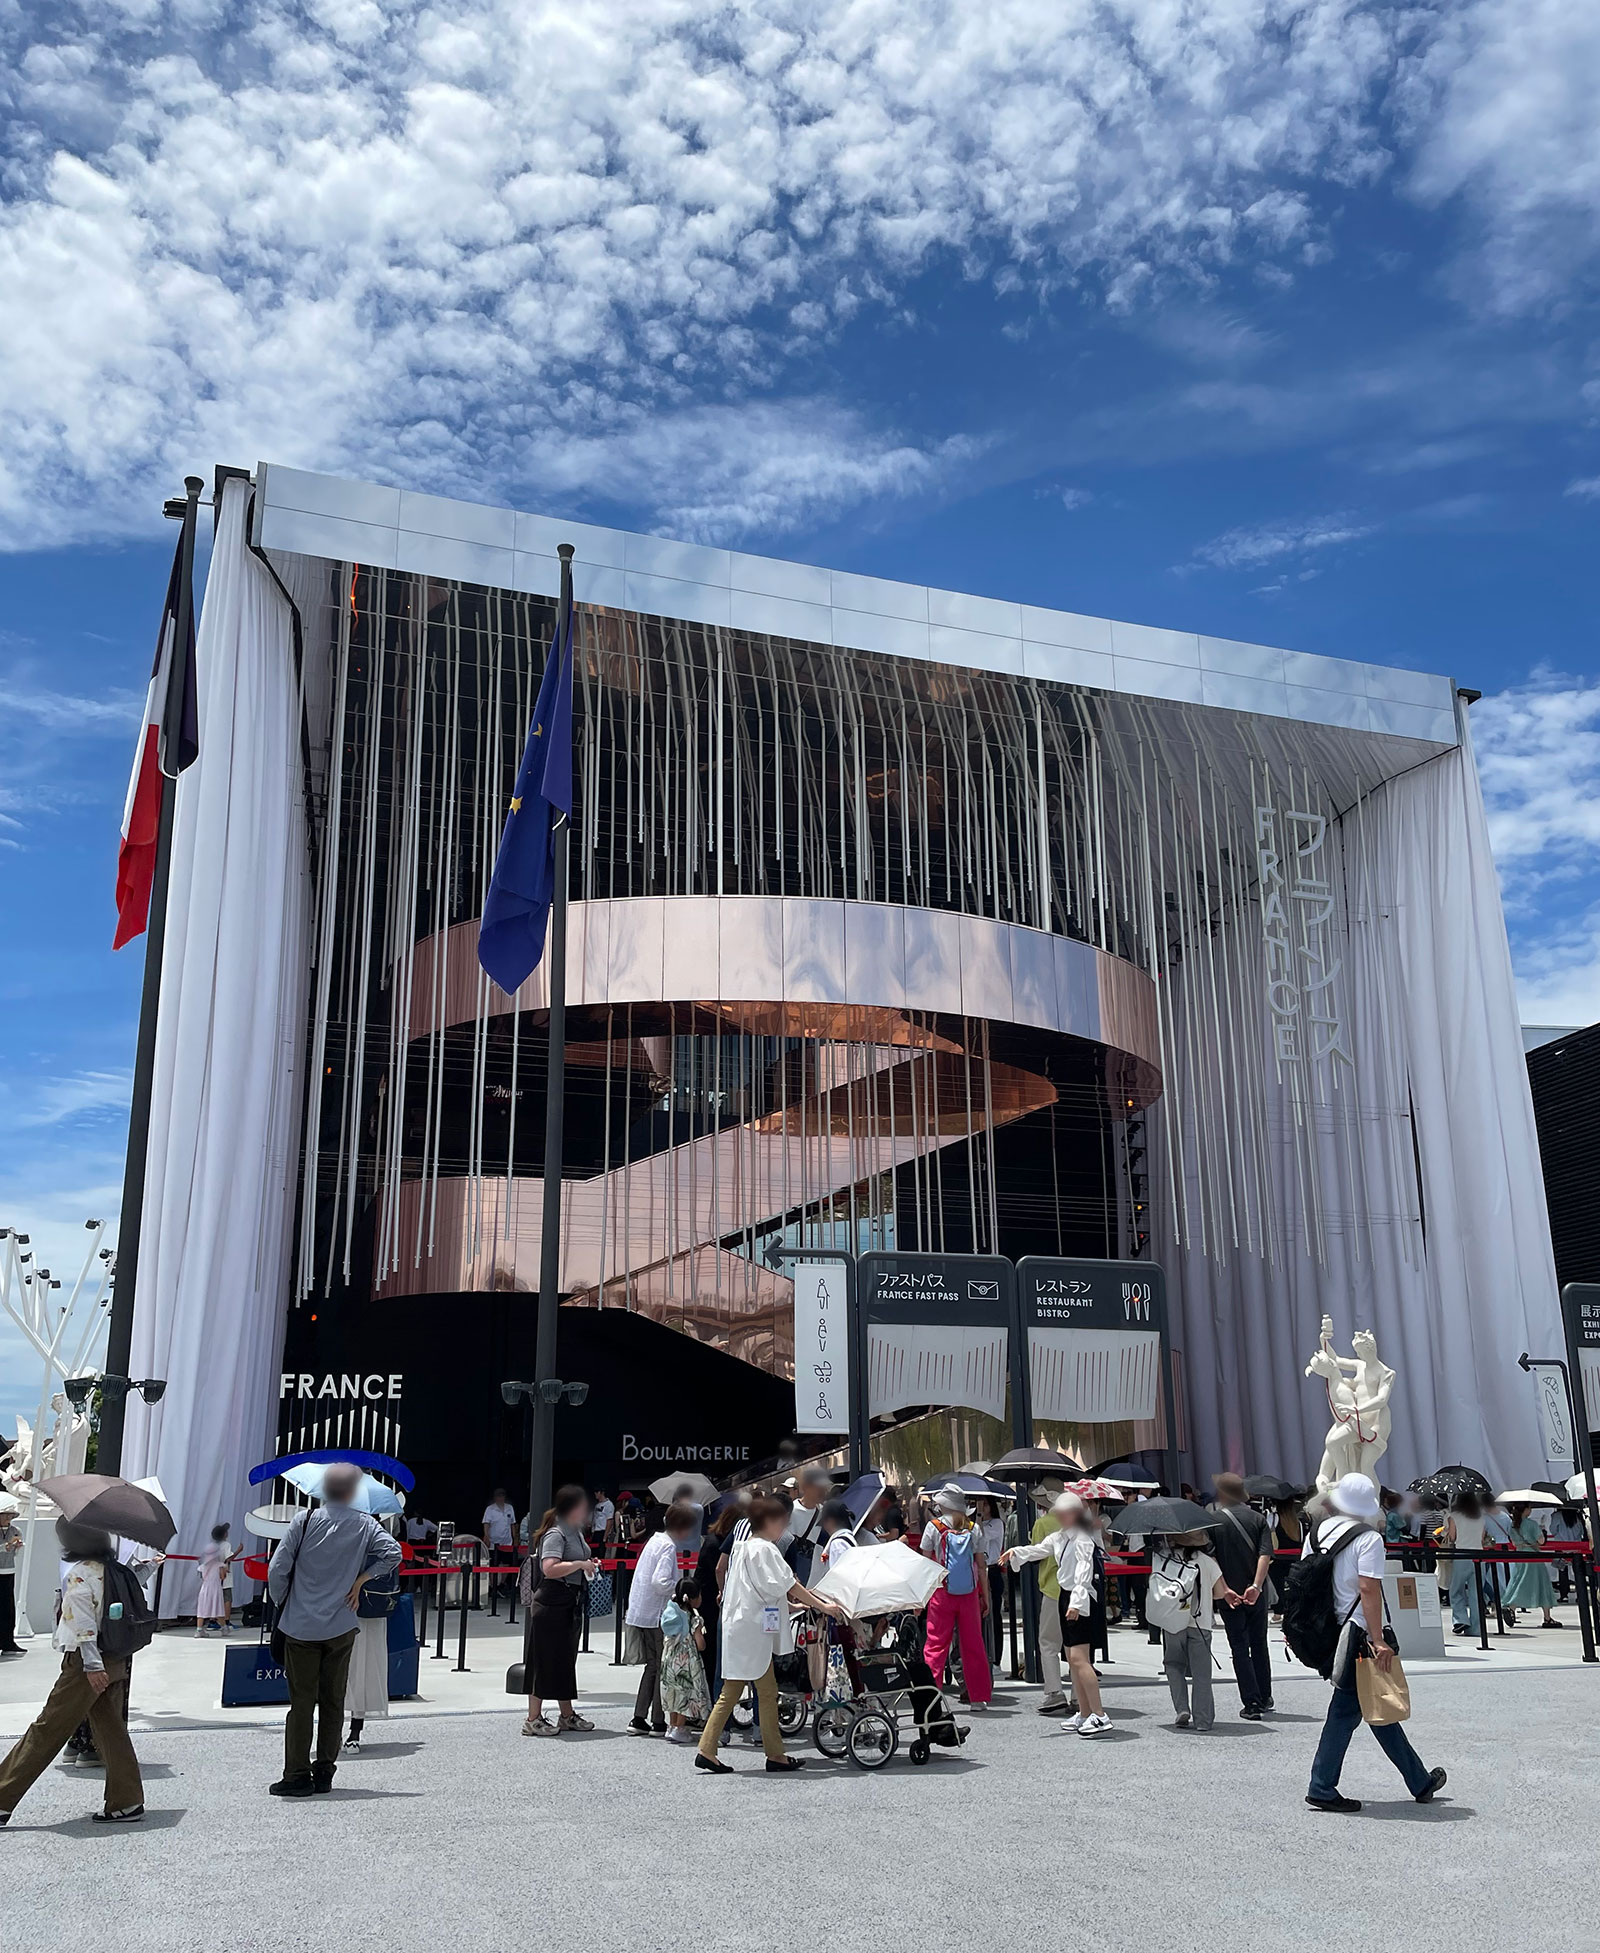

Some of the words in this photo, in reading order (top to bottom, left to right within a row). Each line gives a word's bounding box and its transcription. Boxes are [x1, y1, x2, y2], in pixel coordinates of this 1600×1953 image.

[1255, 806, 1301, 1061] FRANCE
[1284, 810, 1355, 1066] フランス
[877, 1273, 945, 1287] ファストパス
[1035, 1279, 1091, 1294] レストラン
[877, 1290, 913, 1300] FRANCE
[915, 1291, 936, 1300] FAST
[938, 1292, 959, 1301] PASS
[1036, 1296, 1093, 1307] RESTAURANT
[1037, 1308, 1070, 1319] BISTRO
[279, 1373, 403, 1400] FRANCE
